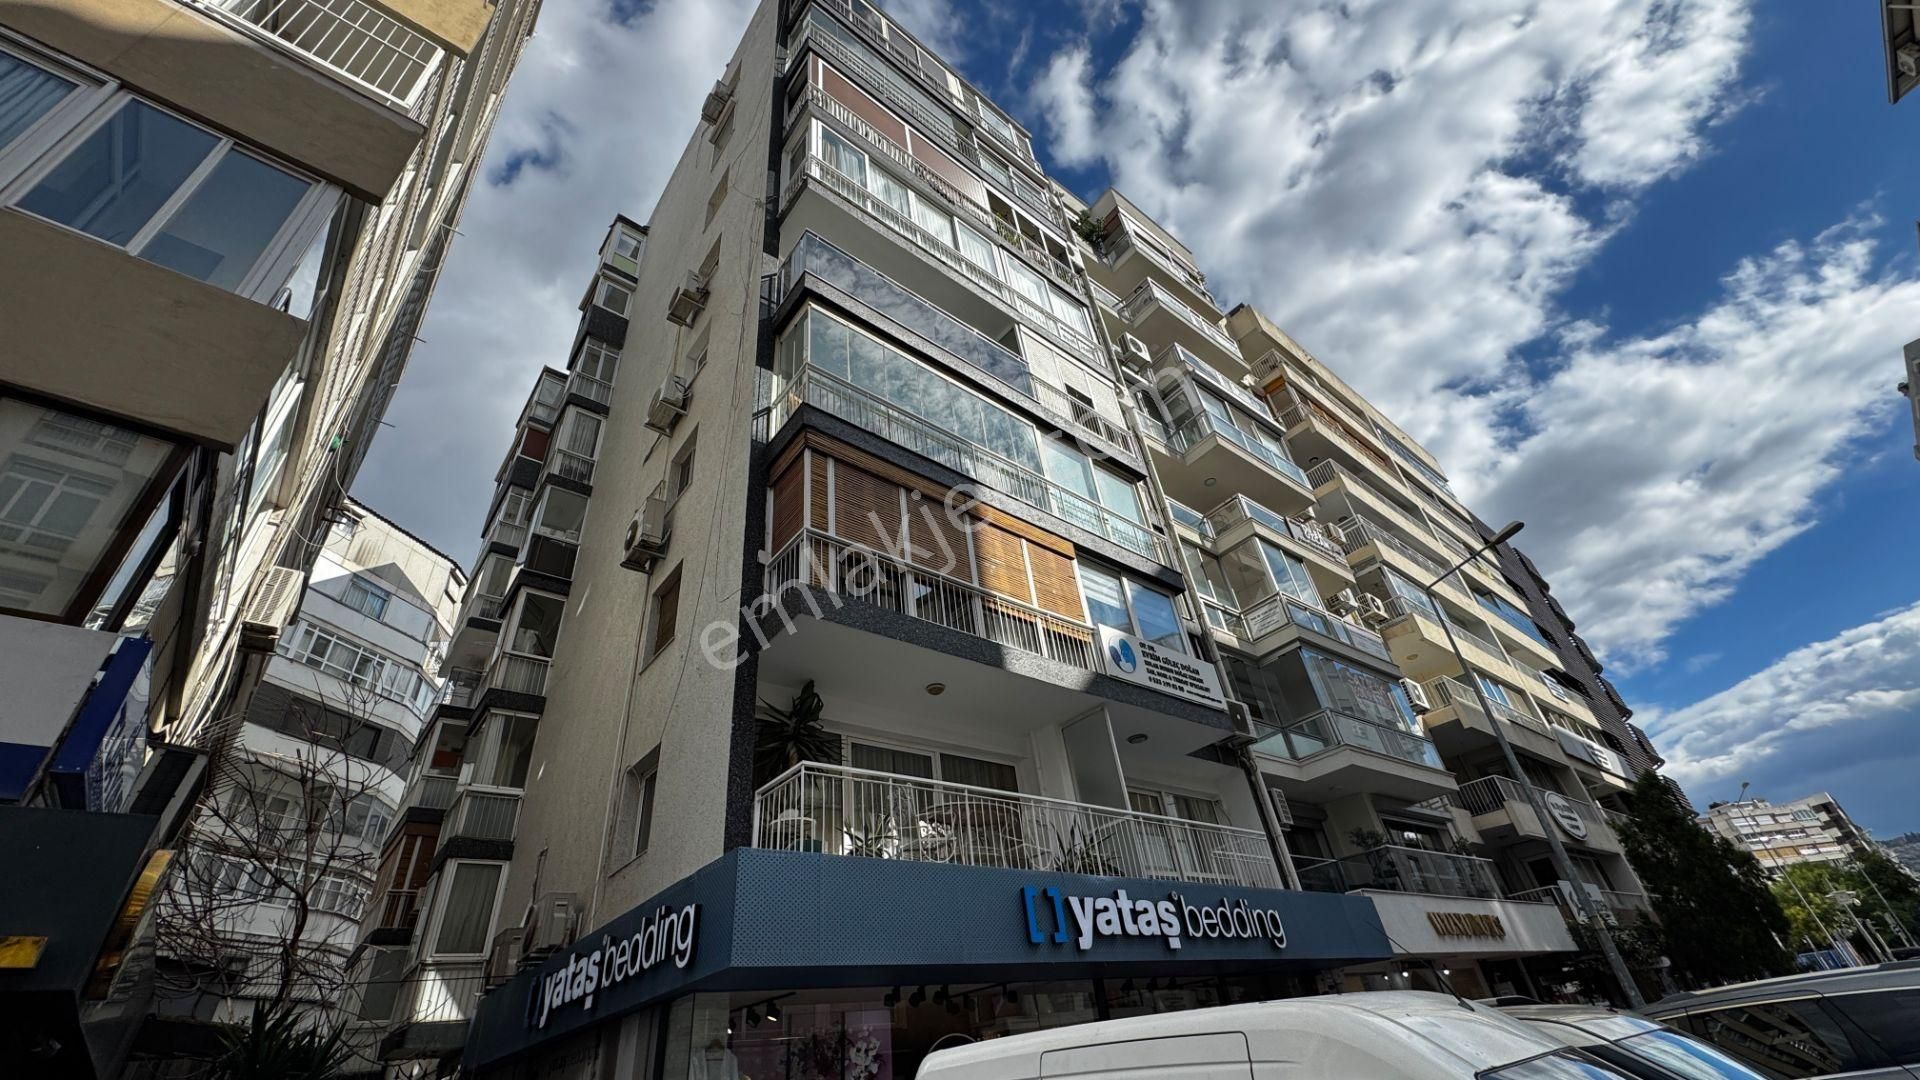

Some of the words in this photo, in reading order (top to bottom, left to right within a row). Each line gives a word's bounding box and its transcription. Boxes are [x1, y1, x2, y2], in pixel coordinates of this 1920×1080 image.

[539, 950, 602, 1029] yataş
[601, 903, 697, 988] bedding
[1068, 889, 1181, 950] yataş
[1180, 894, 1287, 949] bedding
